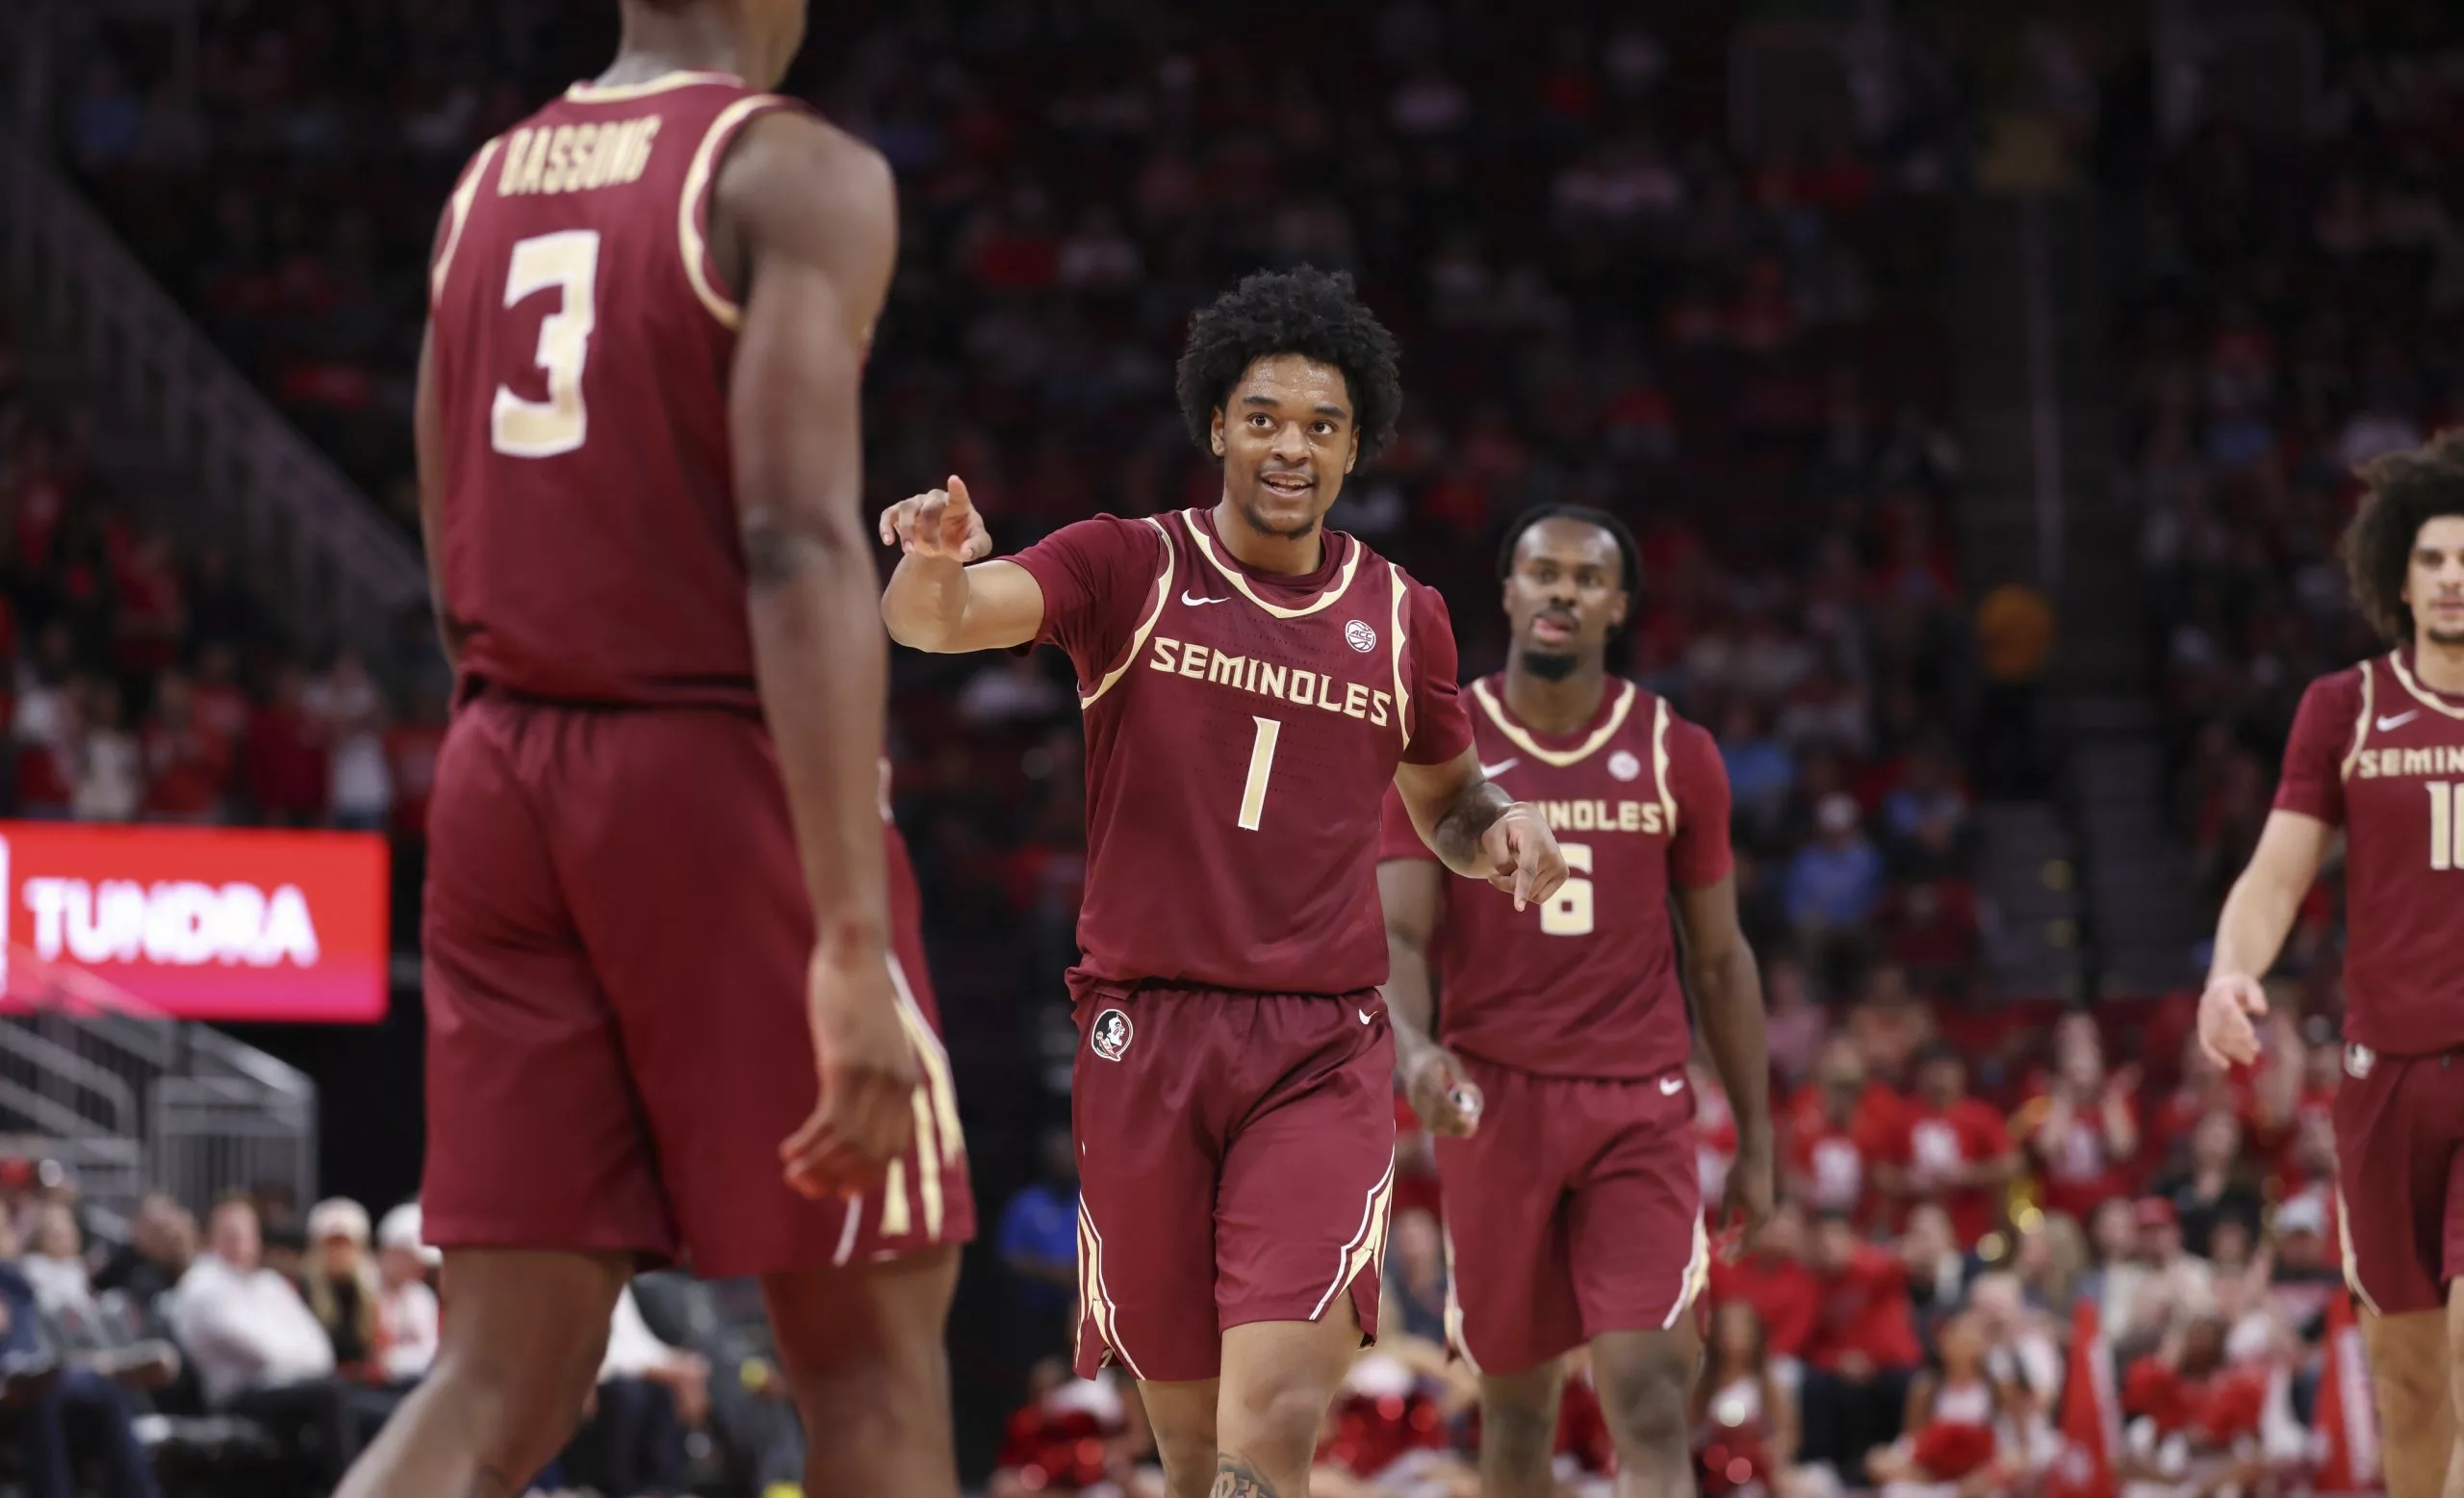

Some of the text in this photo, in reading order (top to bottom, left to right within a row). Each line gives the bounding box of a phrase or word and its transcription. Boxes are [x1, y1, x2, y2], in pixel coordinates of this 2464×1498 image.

[492, 228, 601, 457] 3
[1149, 636, 1392, 728] SEMINOLES
[1238, 715, 1281, 832] 1
[2359, 745, 2464, 779] SEMIN
[1537, 799, 1662, 835] INOLES
[22, 876, 321, 969] TUNDRA
[1540, 841, 1595, 936] 6
